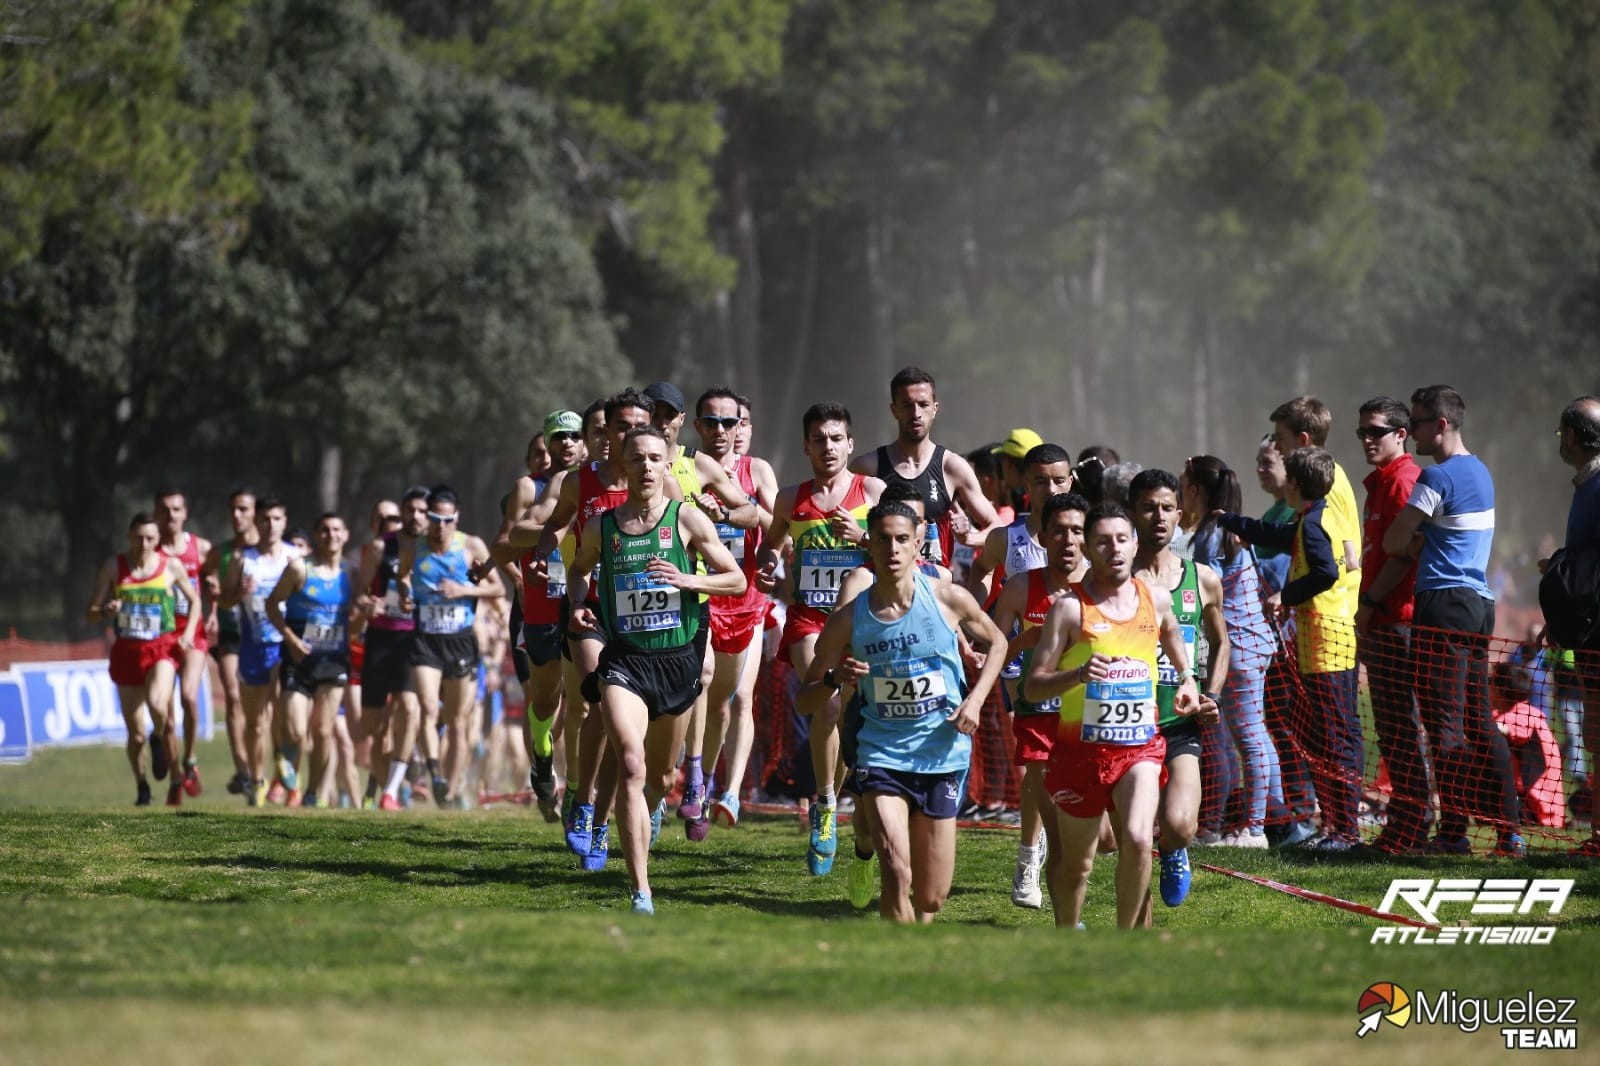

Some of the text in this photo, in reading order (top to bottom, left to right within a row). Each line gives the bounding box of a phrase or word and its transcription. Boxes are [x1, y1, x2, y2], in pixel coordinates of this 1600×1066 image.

[627, 591, 669, 612] 129
[864, 631, 919, 655] nerja
[885, 677, 933, 700] 242
[1096, 702, 1144, 724] 295
